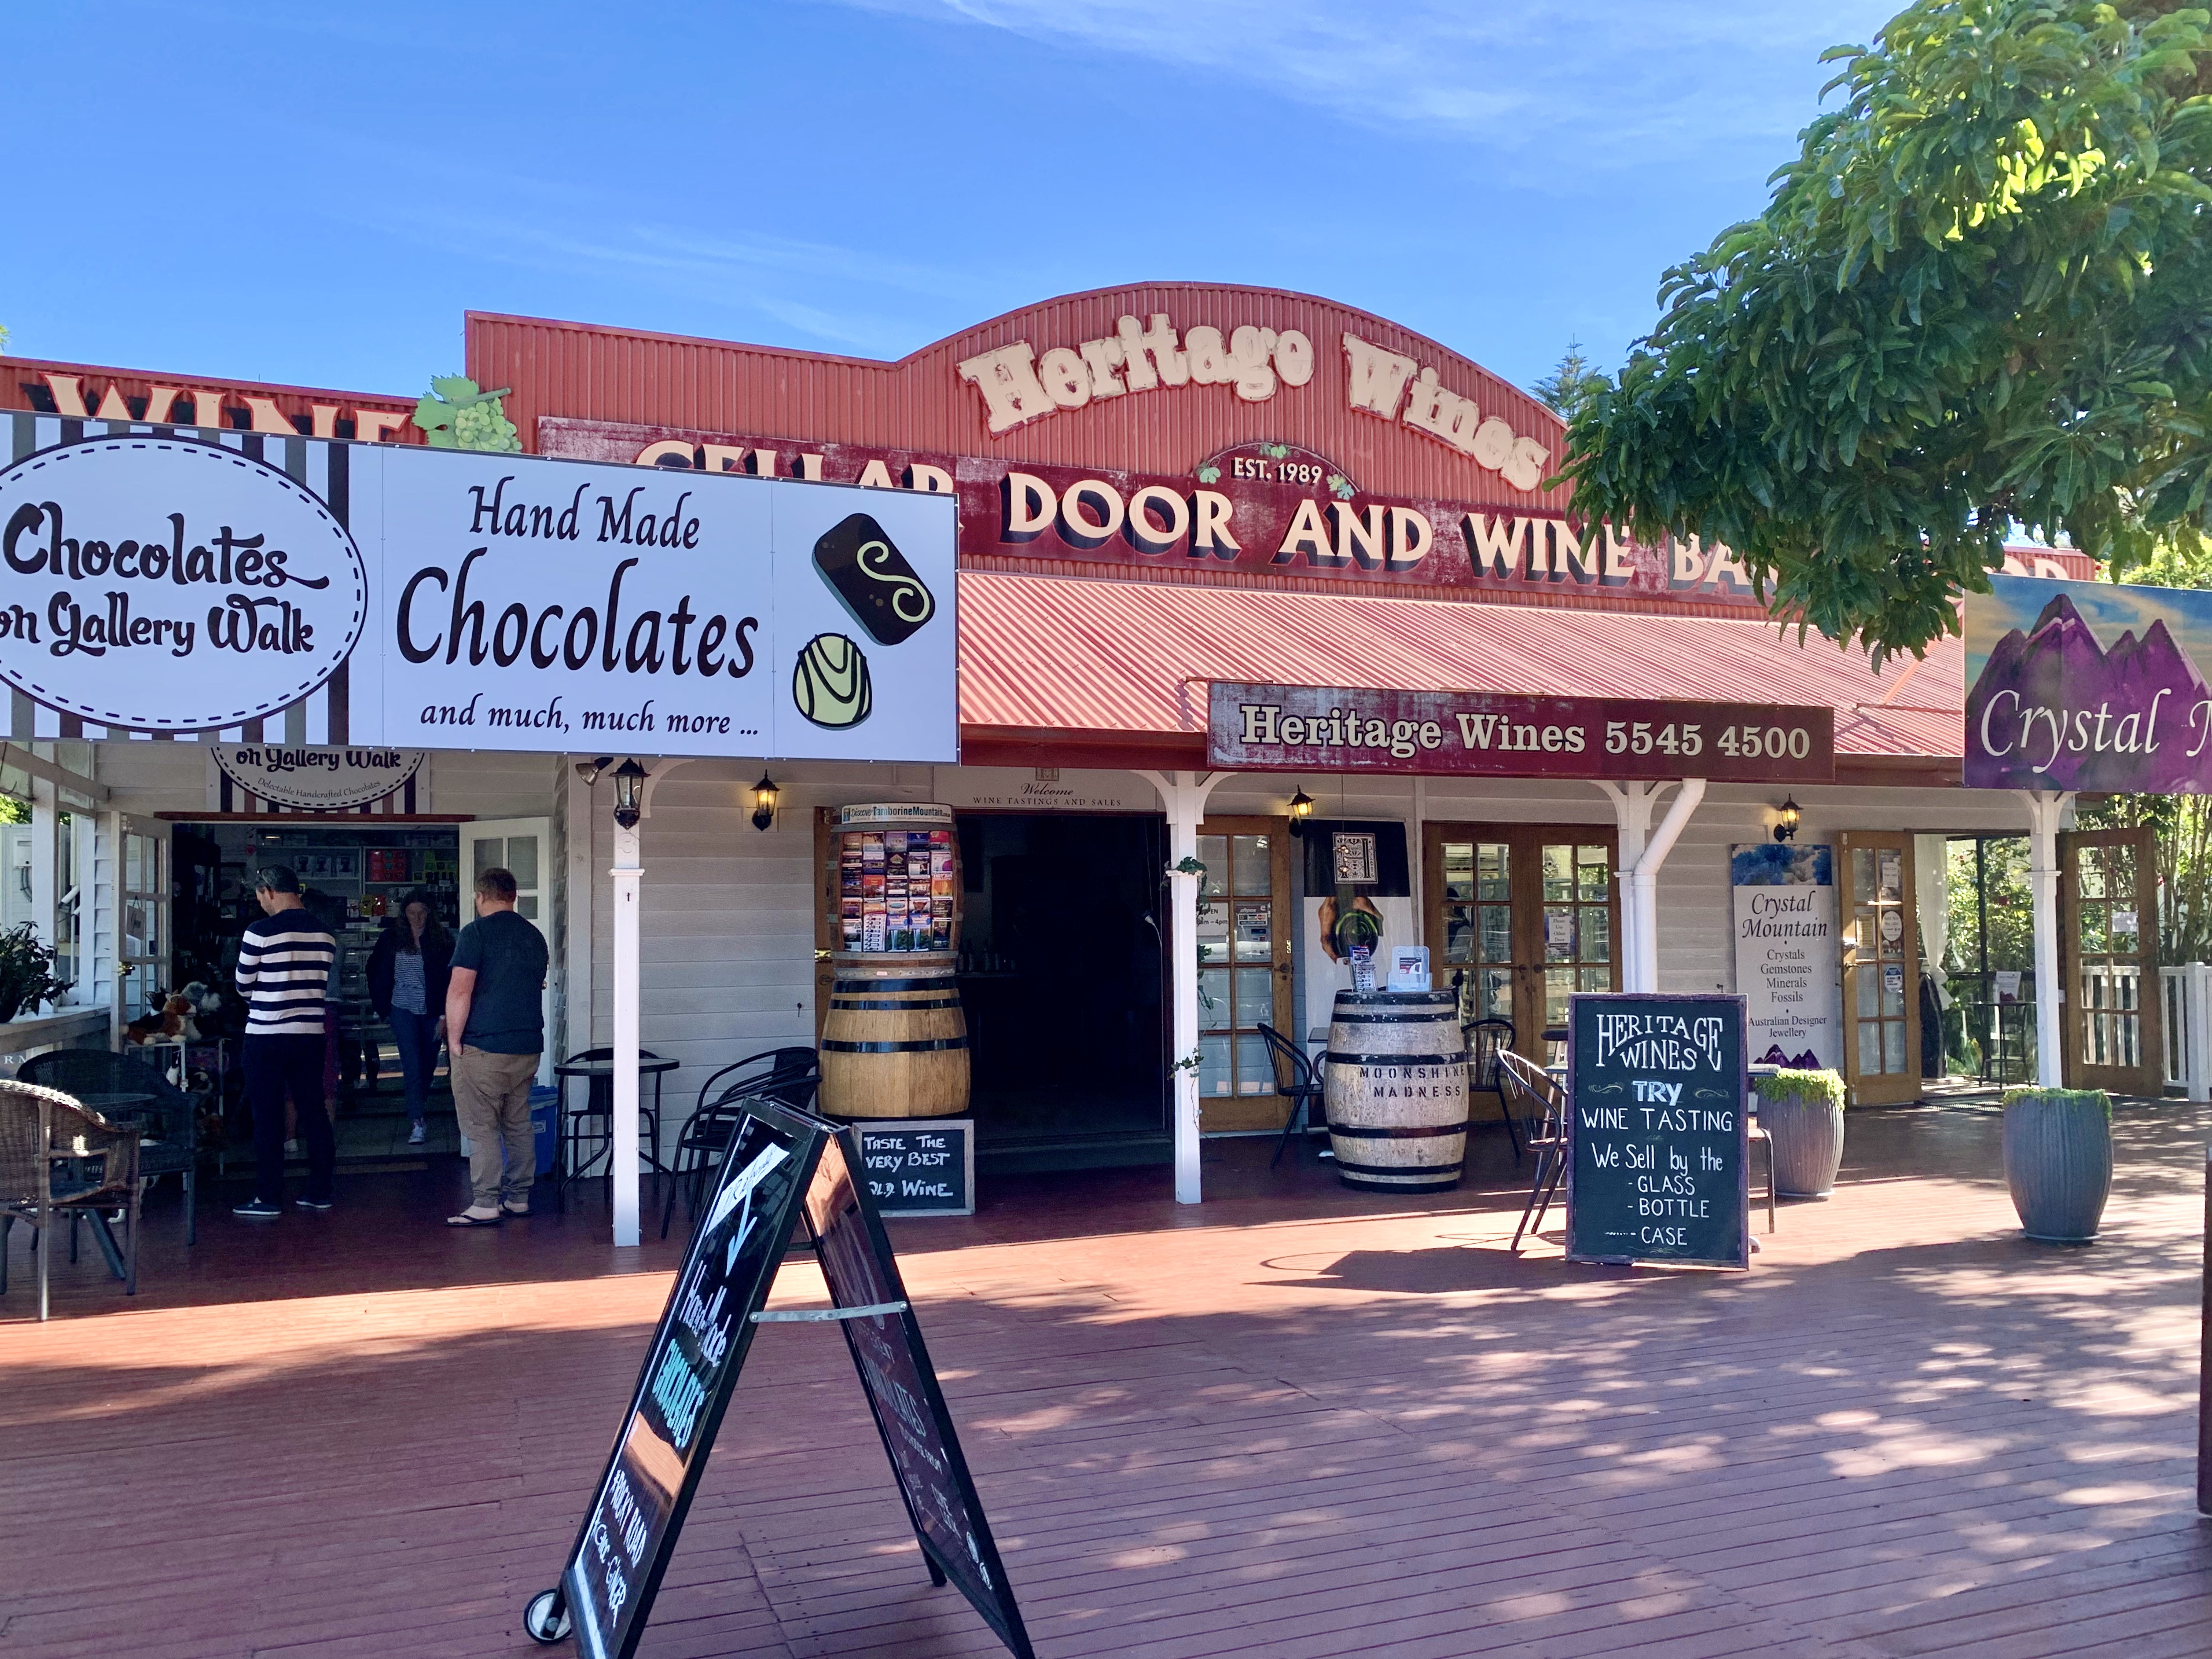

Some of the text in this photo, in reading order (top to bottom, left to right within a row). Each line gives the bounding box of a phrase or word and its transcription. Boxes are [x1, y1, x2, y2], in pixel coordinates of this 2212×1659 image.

[956, 313, 1550, 492] Heritage Wines
[1234, 457, 1322, 483] EST. 1989
[468, 476, 700, 550] Hand Made
[1008, 472, 1240, 550] DOOR
[1277, 498, 1433, 563] AND
[1468, 513, 1638, 577] WINE
[2, 501, 329, 589] Chocolates
[47, 591, 195, 657] Gallery
[207, 593, 314, 654] Walk
[396, 547, 758, 678] Chocolates
[420, 693, 483, 726] and
[487, 696, 570, 735] much,
[582, 700, 655, 732] much
[667, 715, 730, 735] more
[1240, 704, 1810, 759] Heritage Wines 5545 4500
[1981, 688, 2172, 773] Crystal
[236, 748, 401, 772] on Gallery Walk
[258, 777, 381, 800] Delectable Handcrafted Chocolates
[1020, 783, 1074, 796] Welcome
[1751, 890, 1816, 919] Crystal
[1742, 917, 1828, 938] Mountain
[1767, 949, 1805, 962] Crystals
[1761, 963, 1812, 975] Gemstones
[1766, 977, 1807, 988] Minerals
[1771, 992, 1803, 1003] Fossils
[1748, 1016, 1827, 1029] Australian Designer
[1769, 1028, 1807, 1038] Jewellery
[1596, 1014, 1723, 1072] HERITAGE
[1620, 1038, 1697, 1071] WINES
[1360, 1065, 1464, 1078] MOONSHINE
[1374, 1085, 1460, 1098] MADNESS
[1632, 1080, 1683, 1106] TRY
[1581, 1107, 1733, 1132] WINE TASTING
[864, 1135, 946, 1150] TASTE THE
[865, 1152, 950, 1172] VERY BEST
[1591, 1143, 1724, 1176] We Sell by the
[1641, 1226, 1688, 1246] CASE
[652, 1338, 705, 1448] CHOCOLATES
[623, 1507, 647, 1568] ROAD
